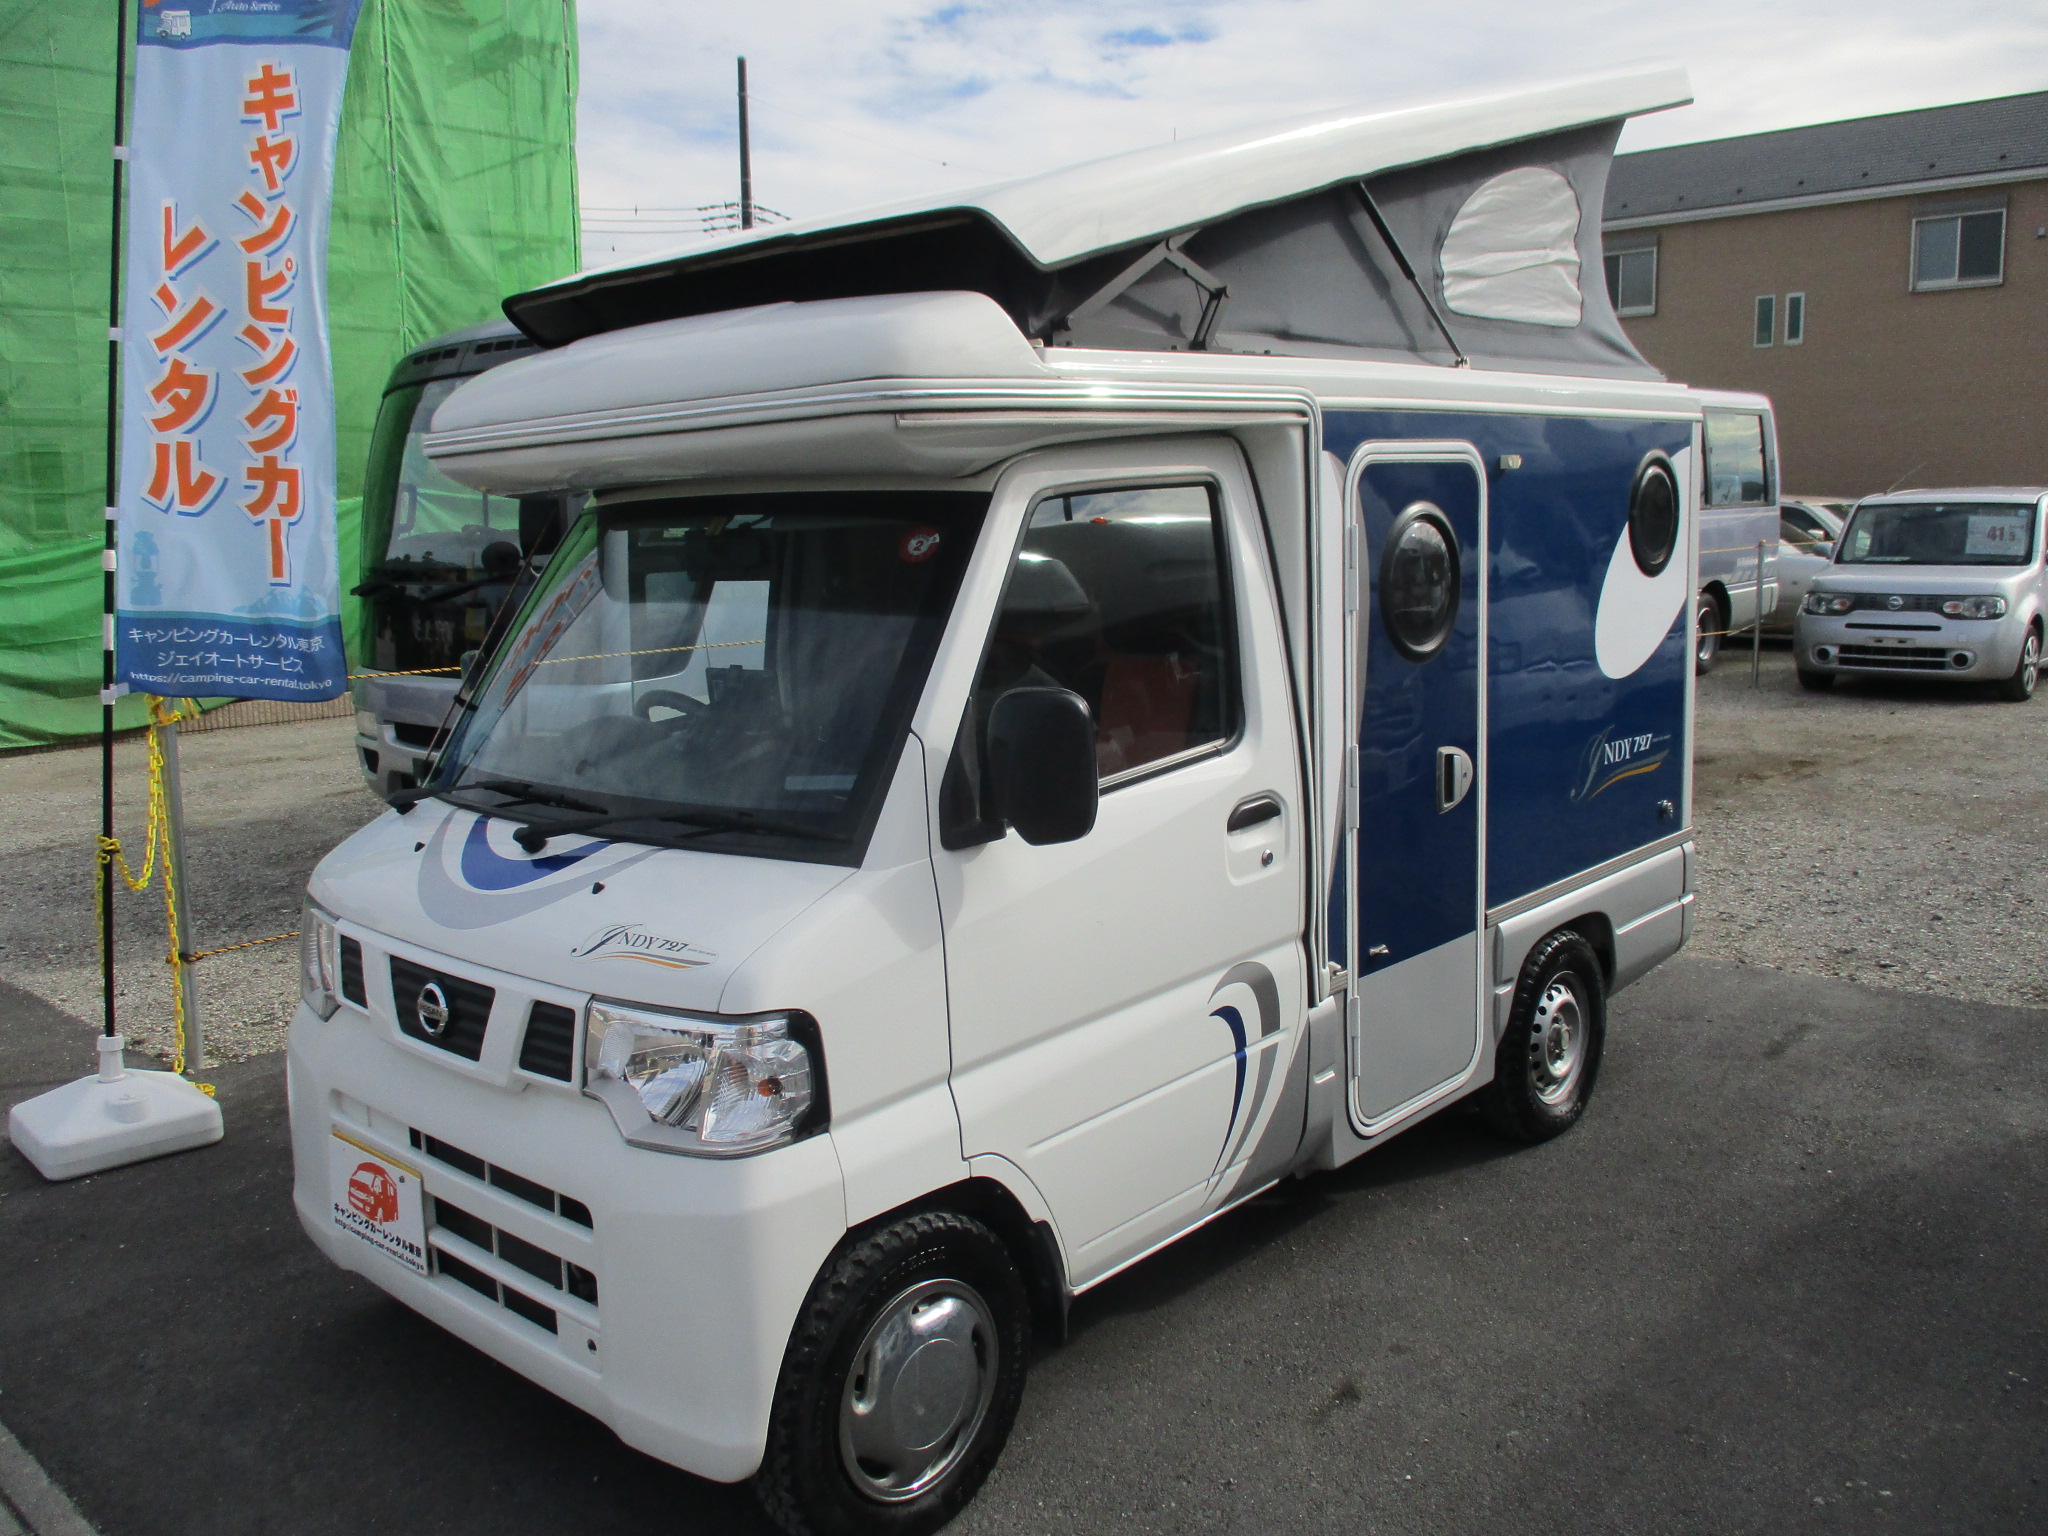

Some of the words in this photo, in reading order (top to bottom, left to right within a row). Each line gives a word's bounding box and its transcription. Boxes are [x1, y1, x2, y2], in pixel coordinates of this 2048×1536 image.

[250, 1, 281, 12] Service
[237, 61, 302, 583] キャンピングカー
[144, 203, 221, 512] レンタル
[128, 627, 325, 653] キャンピングカーレンタル東京
[157, 650, 305, 675] ジェイオートサービス
[129, 671, 333, 691] https://camping-car-rental.tokyo
[1633, 732, 1654, 754] 727
[656, 938, 690, 953] 727
